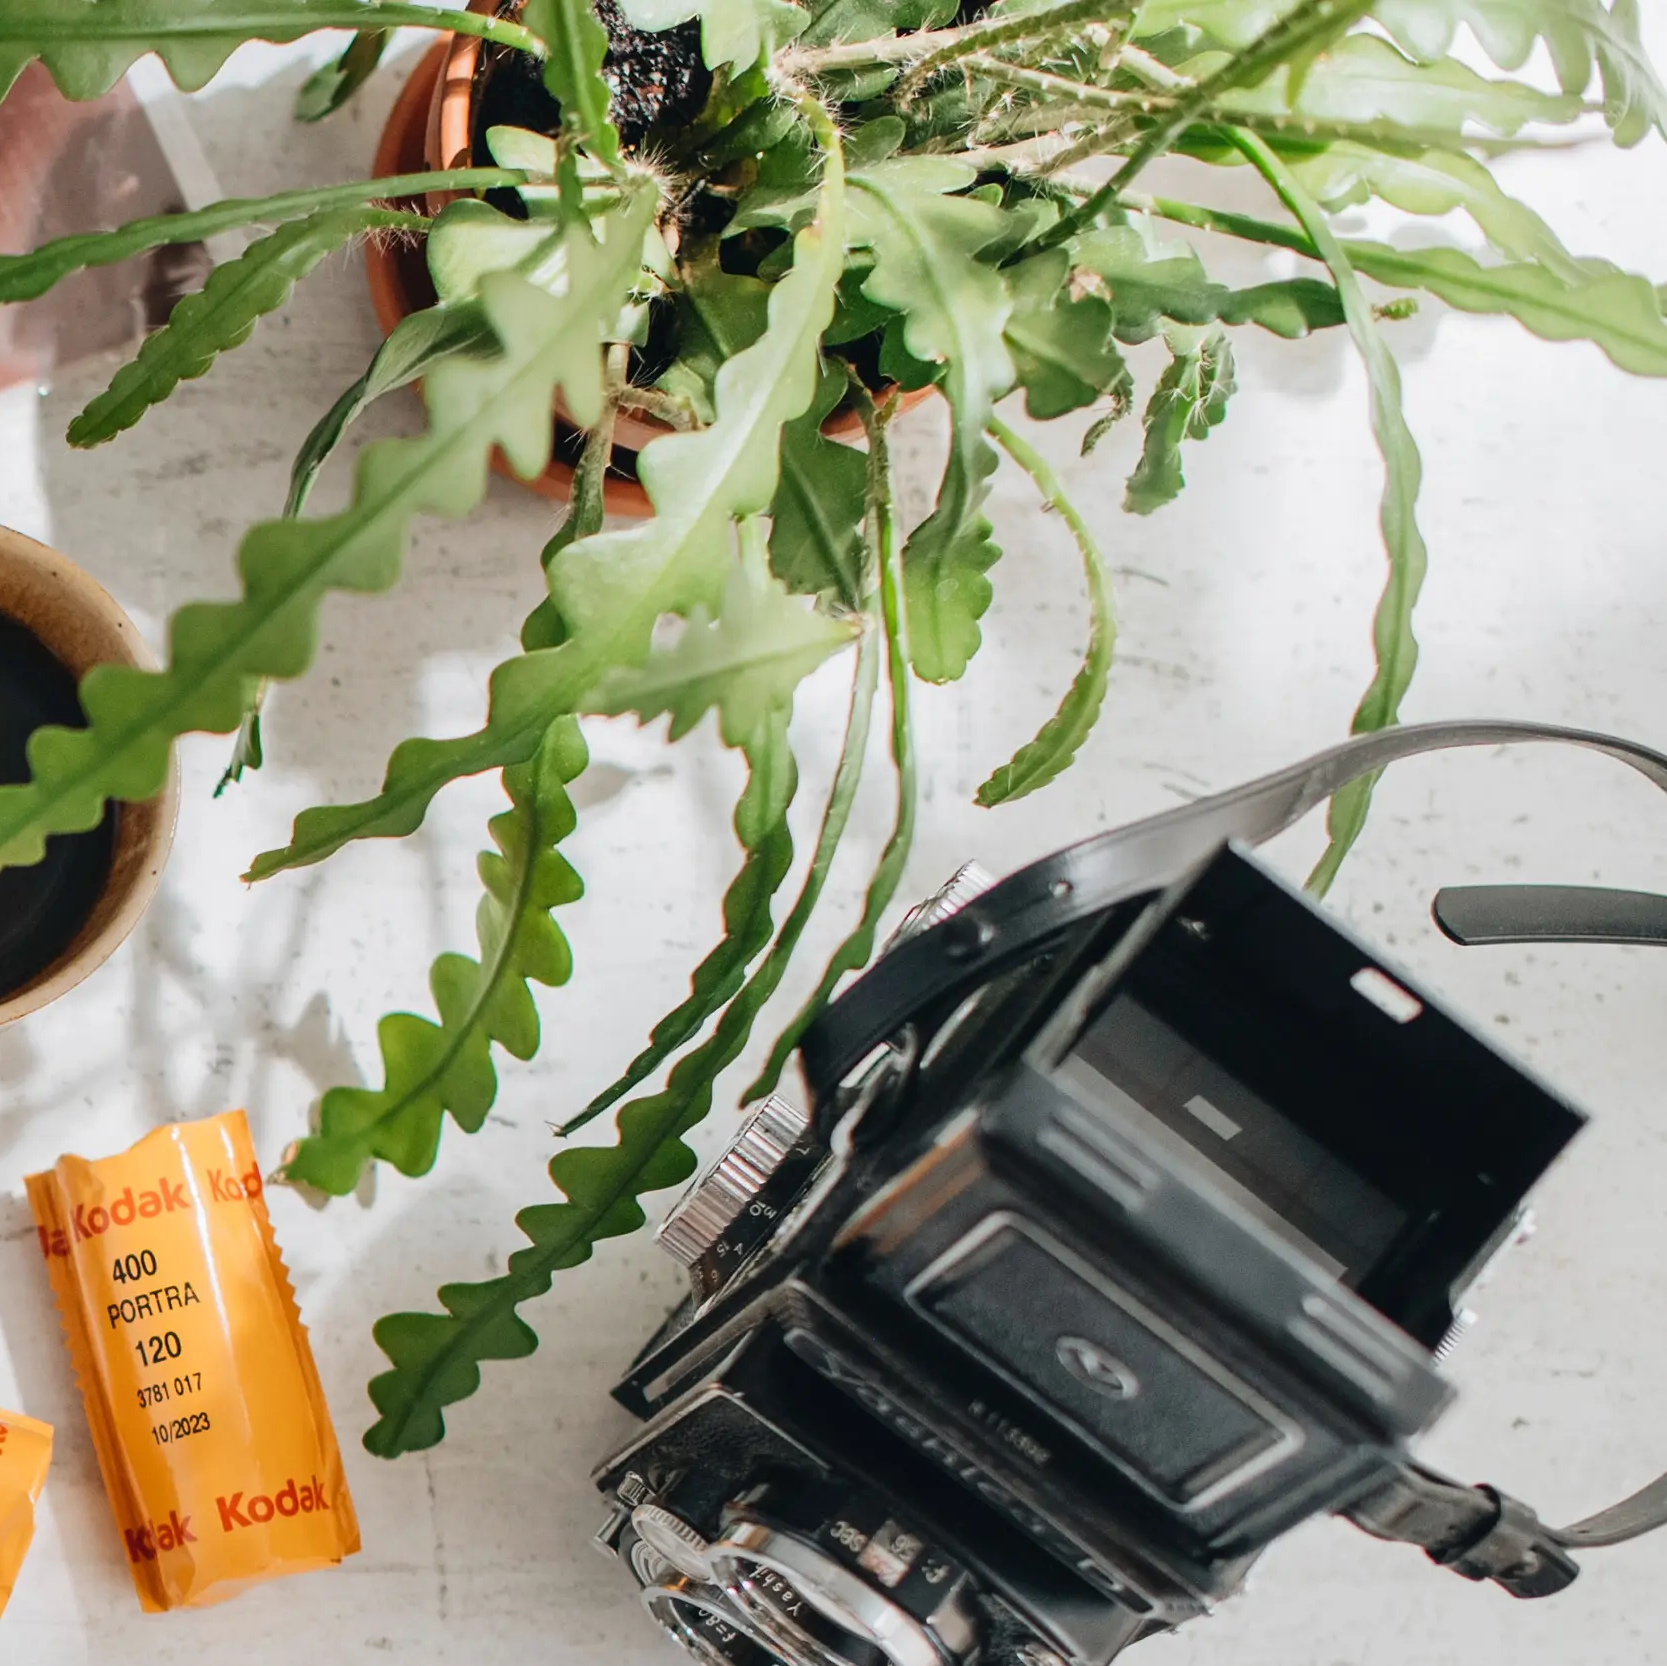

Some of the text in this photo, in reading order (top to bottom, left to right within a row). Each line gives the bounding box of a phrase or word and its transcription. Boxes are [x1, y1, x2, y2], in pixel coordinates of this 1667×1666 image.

[71, 1176, 191, 1243] Kodak
[112, 1249, 158, 1284] 400
[107, 1281, 201, 1330] PORTRA
[135, 1331, 182, 1367] 120
[136, 1372, 203, 1409] 3781 017
[151, 1412, 212, 1446] 10/2023
[215, 1475, 330, 1533] Kodak
